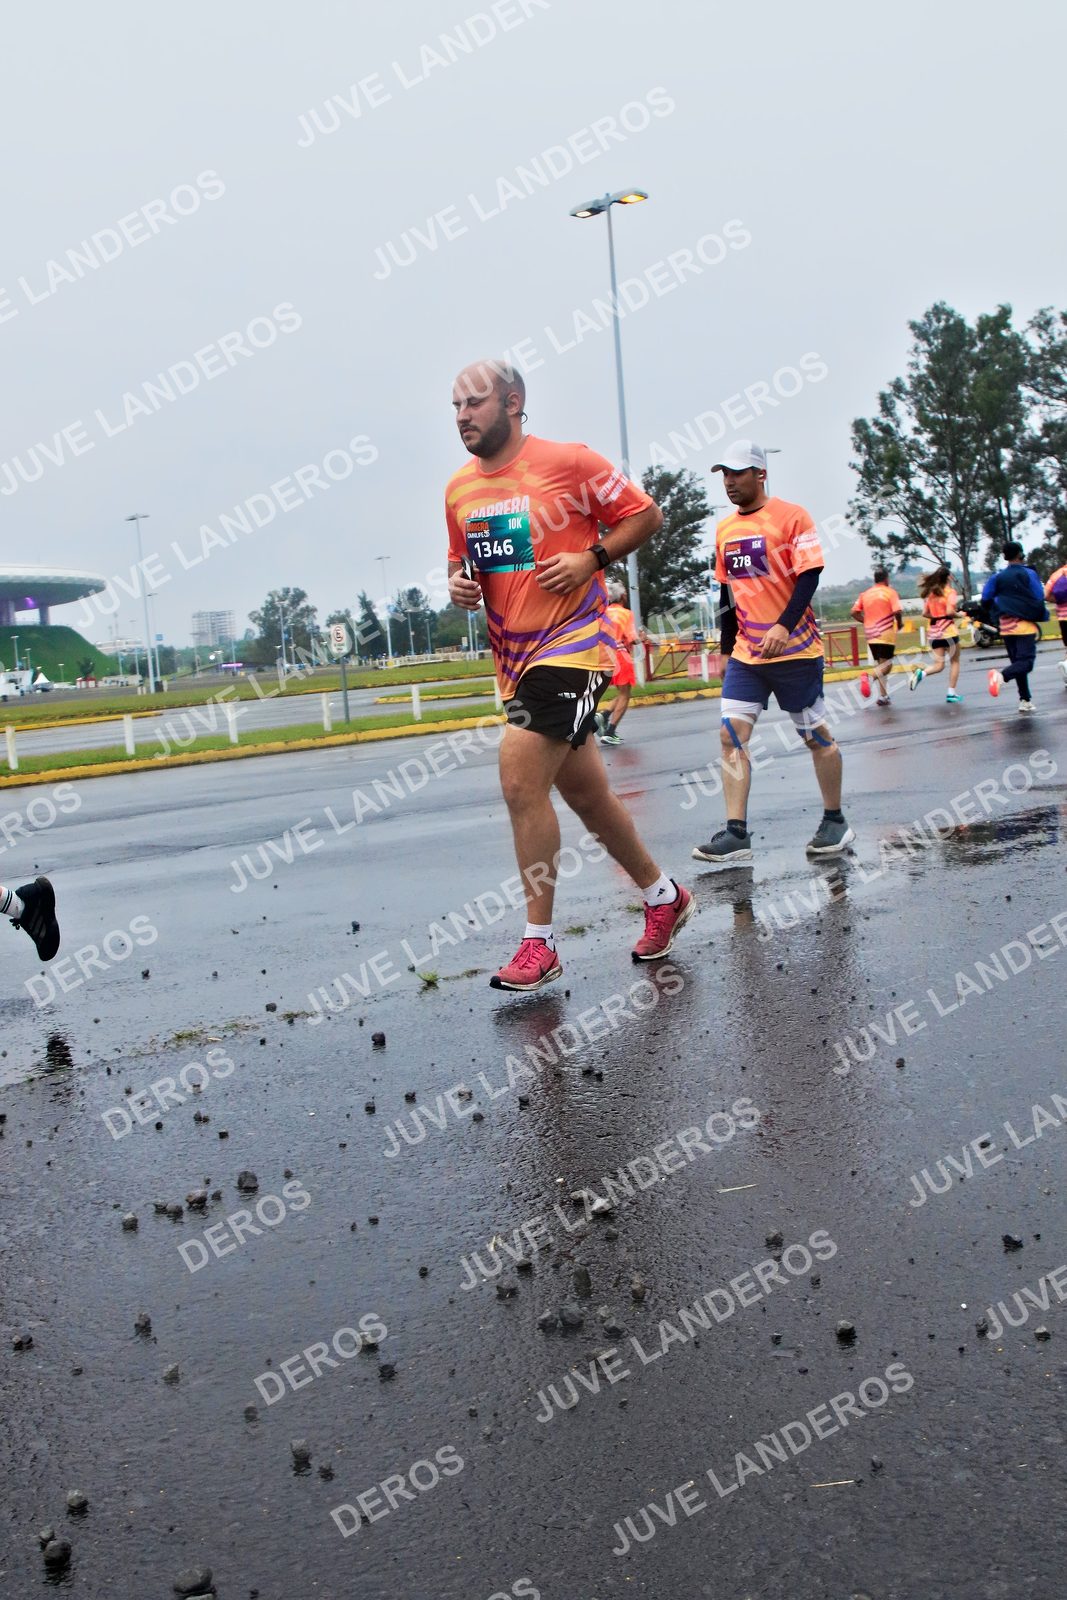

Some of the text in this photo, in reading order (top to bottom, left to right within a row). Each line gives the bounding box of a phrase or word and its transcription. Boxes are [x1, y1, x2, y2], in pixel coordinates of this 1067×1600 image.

[508, 517, 522, 530] 10K
[474, 538, 514, 558] 1346
[732, 555, 751, 568] 278
